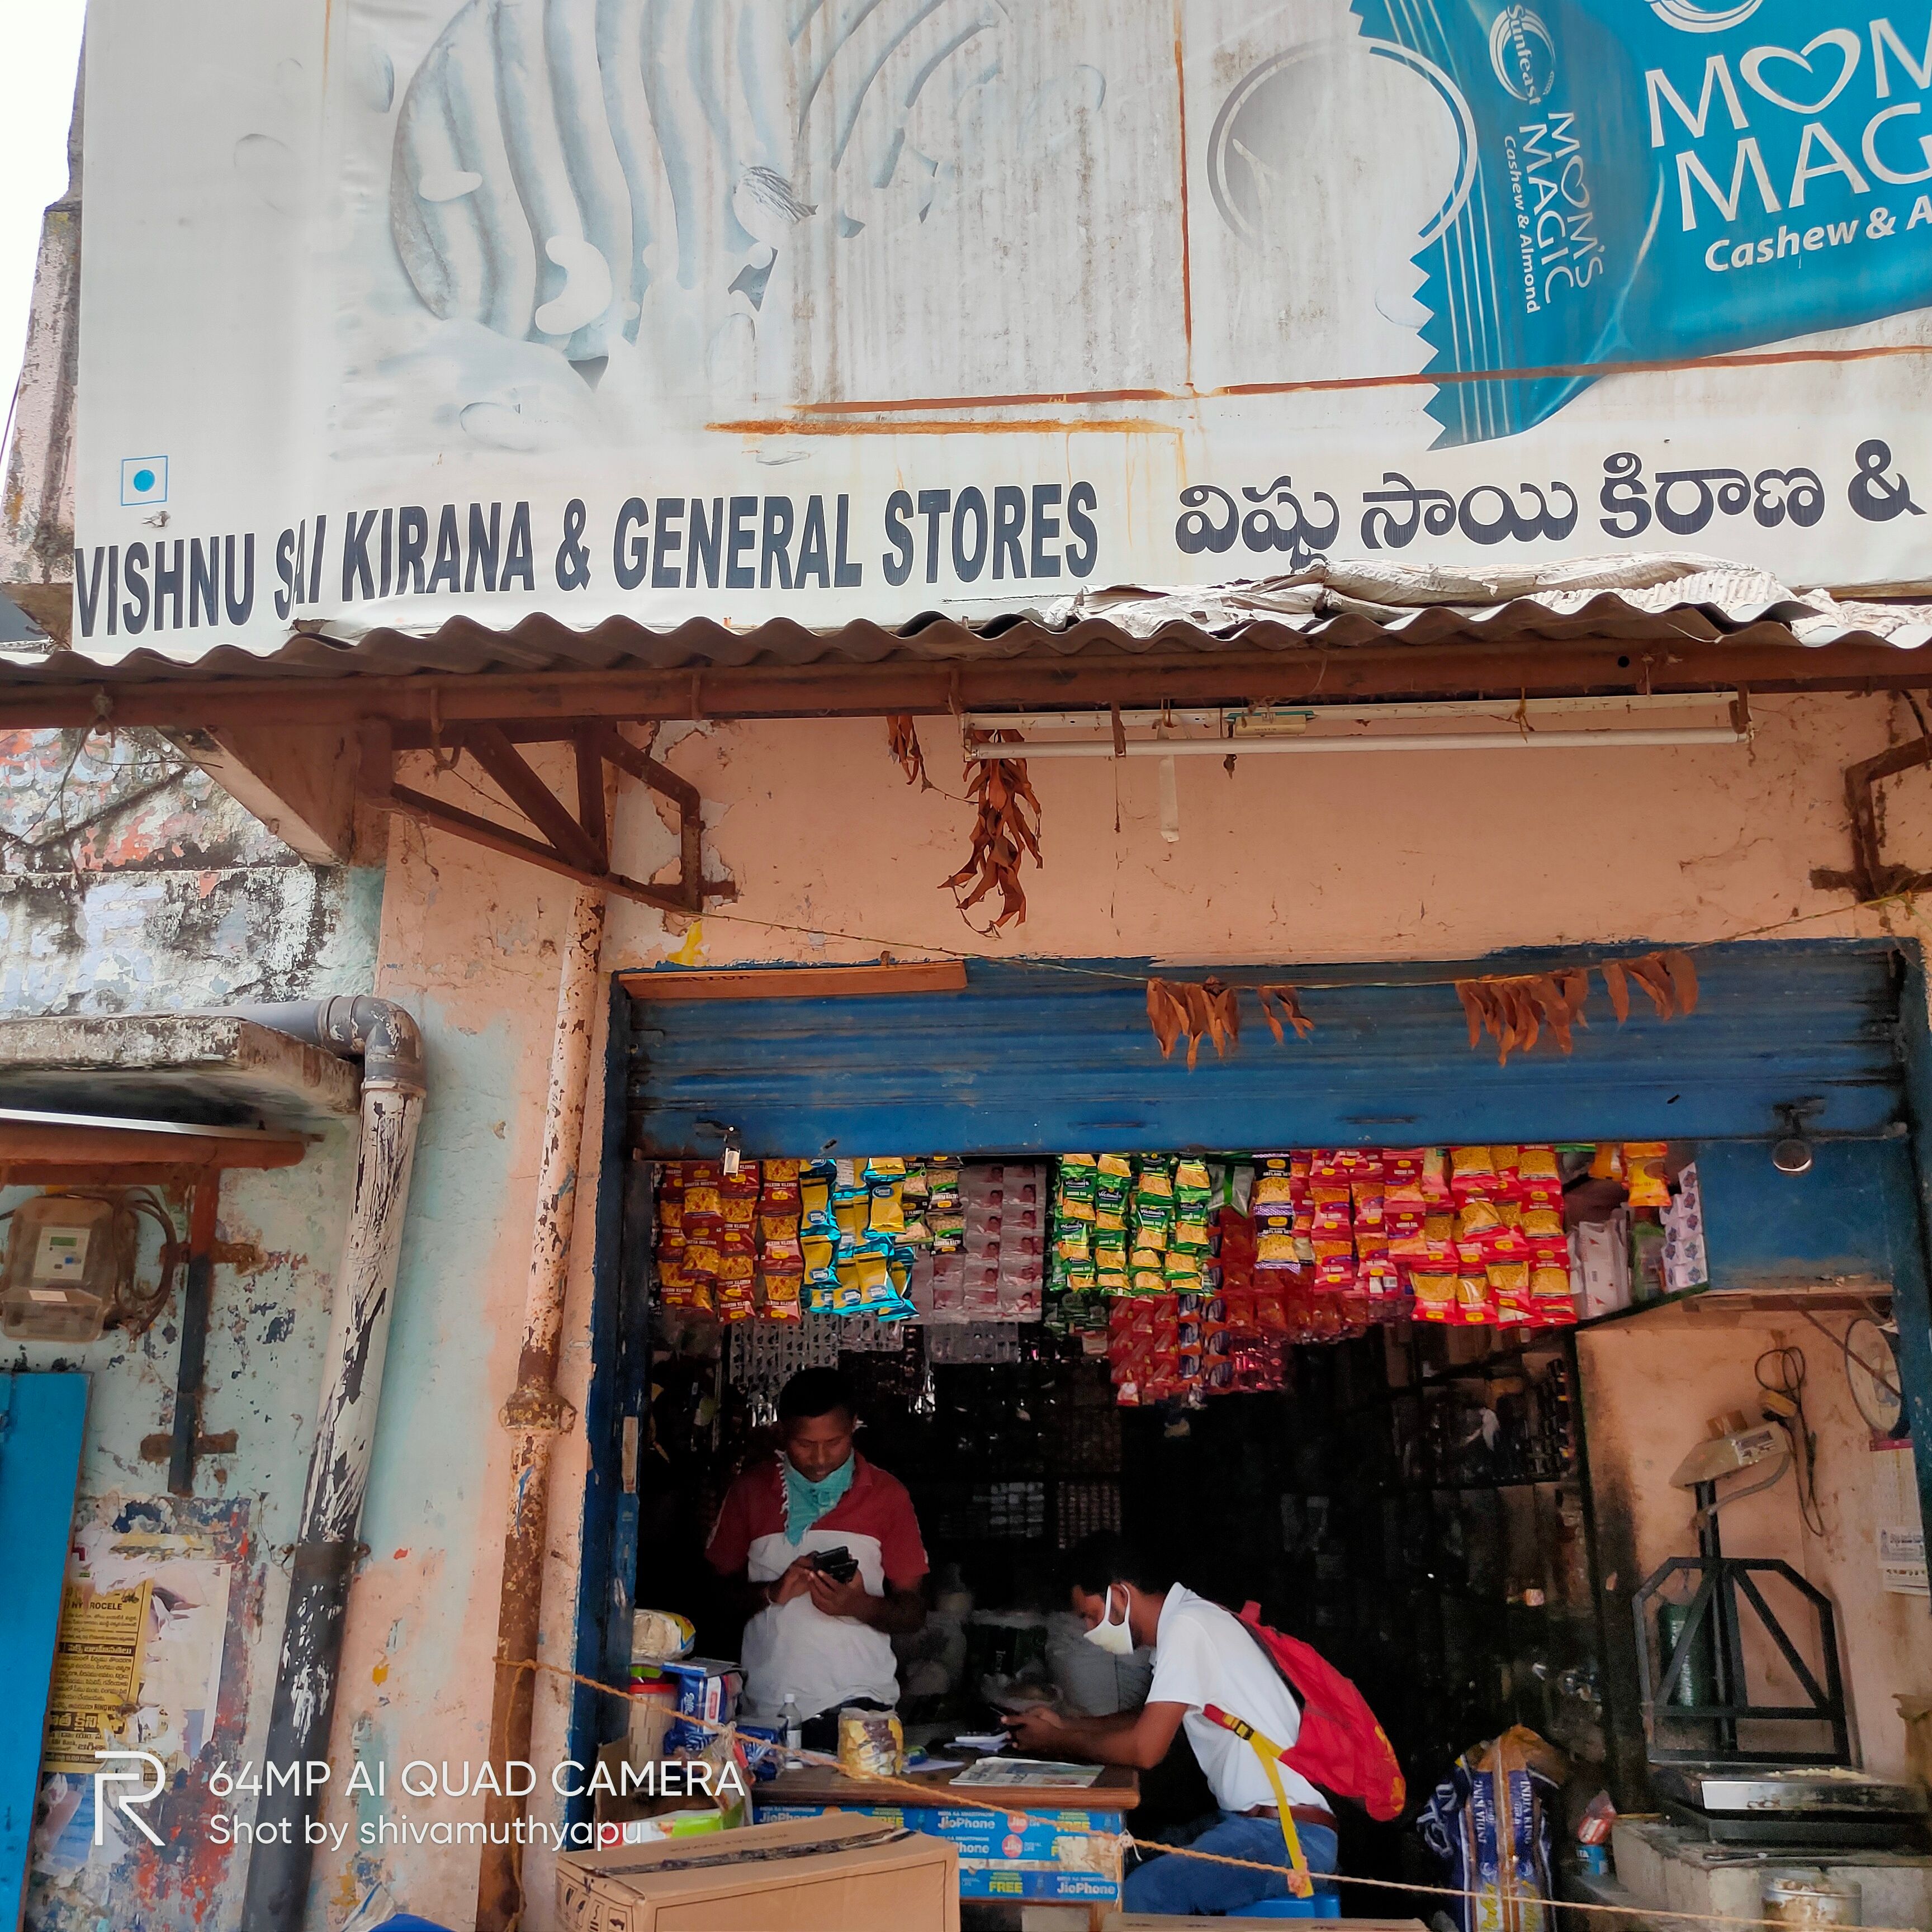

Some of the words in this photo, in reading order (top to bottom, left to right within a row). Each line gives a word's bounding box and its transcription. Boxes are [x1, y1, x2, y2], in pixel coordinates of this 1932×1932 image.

[1507, 3, 1541, 105] Sunfeast
[1504, 135, 1524, 210] Cashew
[1517, 214, 1530, 229] &
[1519, 124, 1574, 304] MAGIC
[1704, 220, 1859, 272] Cashew
[1865, 207, 1896, 239] &
[1519, 234, 1541, 314] Almond
[1361, 472, 1578, 550] సాయి
[1599, 452, 1825, 539] కిరాణ
[1848, 439, 1927, 522] &
[75, 531, 255, 637] VISHNU
[274, 515, 326, 621] SAI
[342, 501, 535, 602] KIRANA
[555, 498, 591, 591] &
[613, 494, 863, 590] GENERAL
[882, 481, 1098, 587] STORES
[937, 1816, 996, 1830] JioPhone
[988, 1881, 1024, 1894] FREE
[1057, 1881, 1115, 1894] JioPhone
